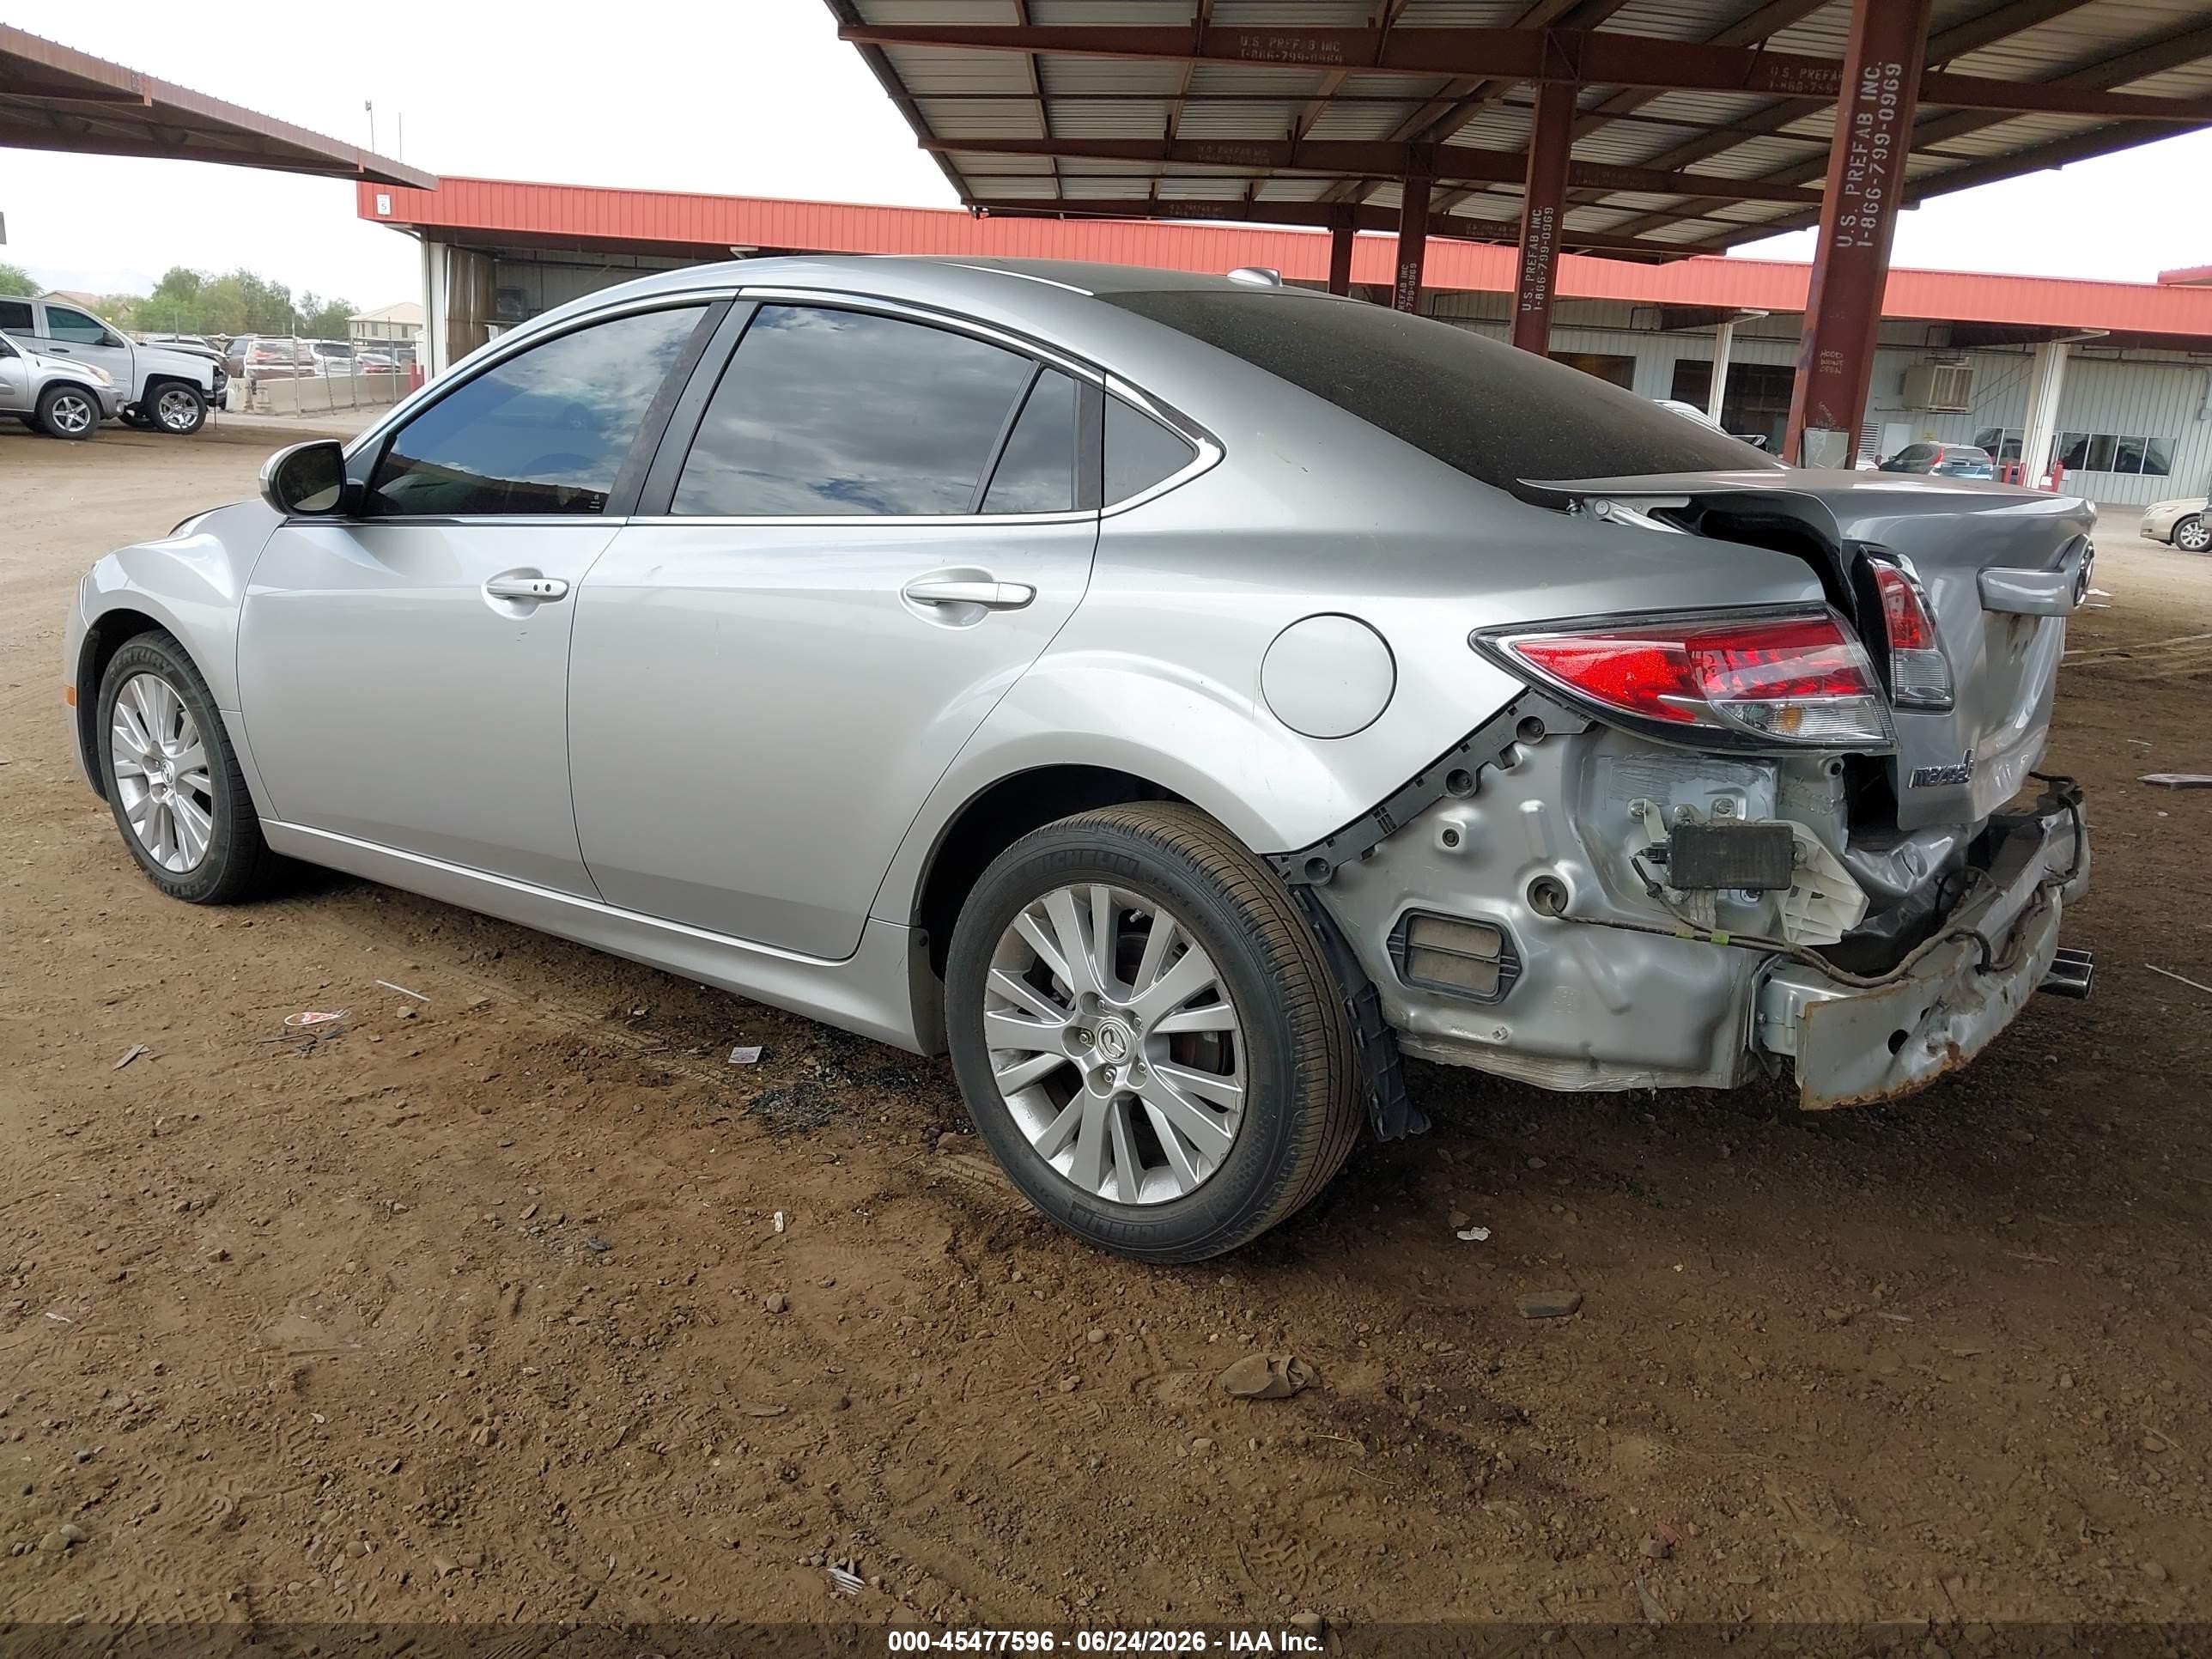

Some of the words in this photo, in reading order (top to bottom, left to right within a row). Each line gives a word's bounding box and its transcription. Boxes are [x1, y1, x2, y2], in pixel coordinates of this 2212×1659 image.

[1269, 36, 1316, 51] PREFB
[1860, 61, 1882, 100] INC.
[1844, 112, 1874, 196] PREFAB
[1856, 63, 1902, 247] 1-866-799-0969
[1837, 209, 1858, 247] U.S.
[1524, 234, 1540, 282] PREFAB
[1533, 207, 1554, 310] 1-866-799-0969
[1522, 288, 1534, 311] U.S.
